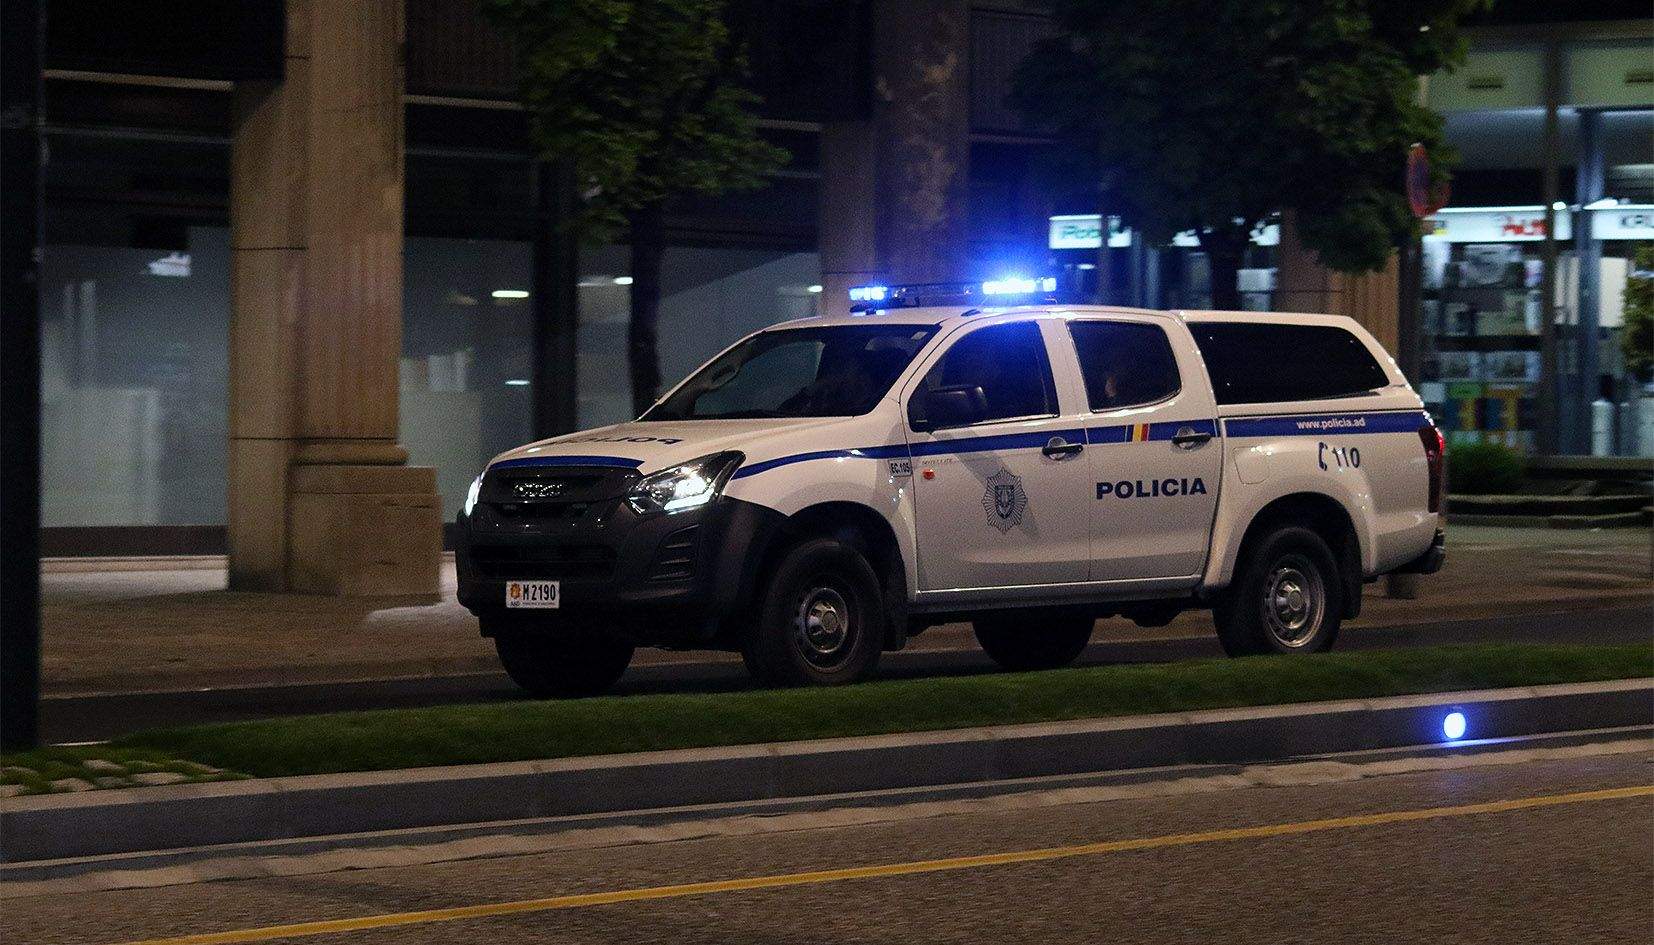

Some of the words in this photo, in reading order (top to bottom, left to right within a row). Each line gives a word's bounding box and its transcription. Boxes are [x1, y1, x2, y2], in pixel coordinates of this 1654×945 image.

[1297, 417, 1366, 430] www.policia.ad
[1332, 447, 1360, 468] 110
[1096, 477, 1207, 500] POLICIA
